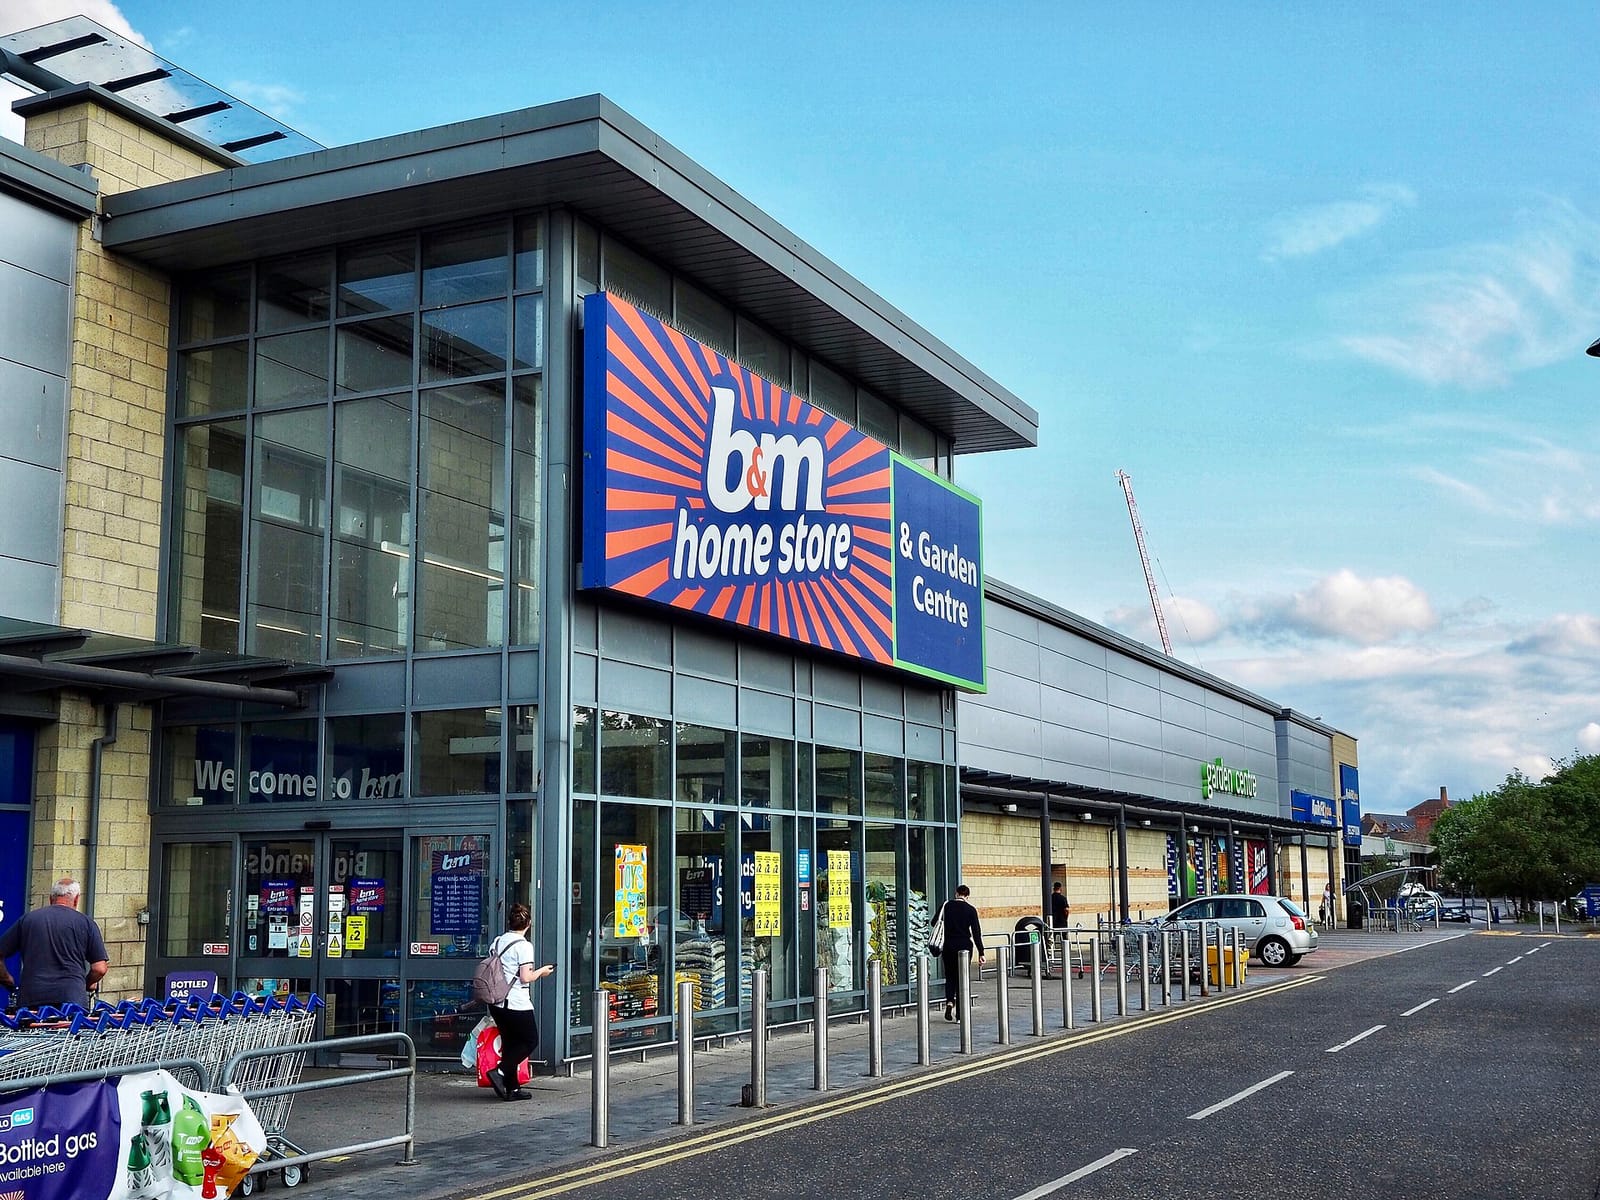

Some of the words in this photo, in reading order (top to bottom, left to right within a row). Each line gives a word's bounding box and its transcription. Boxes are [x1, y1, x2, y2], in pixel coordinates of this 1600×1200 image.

[673, 508, 773, 580] home
[778, 514, 850, 574] store
[900, 521, 913, 560] &
[918, 531, 978, 588] Garden
[912, 575, 969, 628] Centre
[195, 759, 317, 797] Wecome
[1205, 758, 1233, 800] garden
[1235, 769, 1257, 798] centre
[618, 864, 644, 891] TOYS
[350, 930, 361, 941] £2
[170, 980, 208, 989] BOTTLED
[170, 990, 189, 998] GAS
[15, 1112, 31, 1122] GAS
[0, 1134, 59, 1165] Bottled
[65, 1132, 98, 1158] gas
[42, 1161, 66, 1175] here
